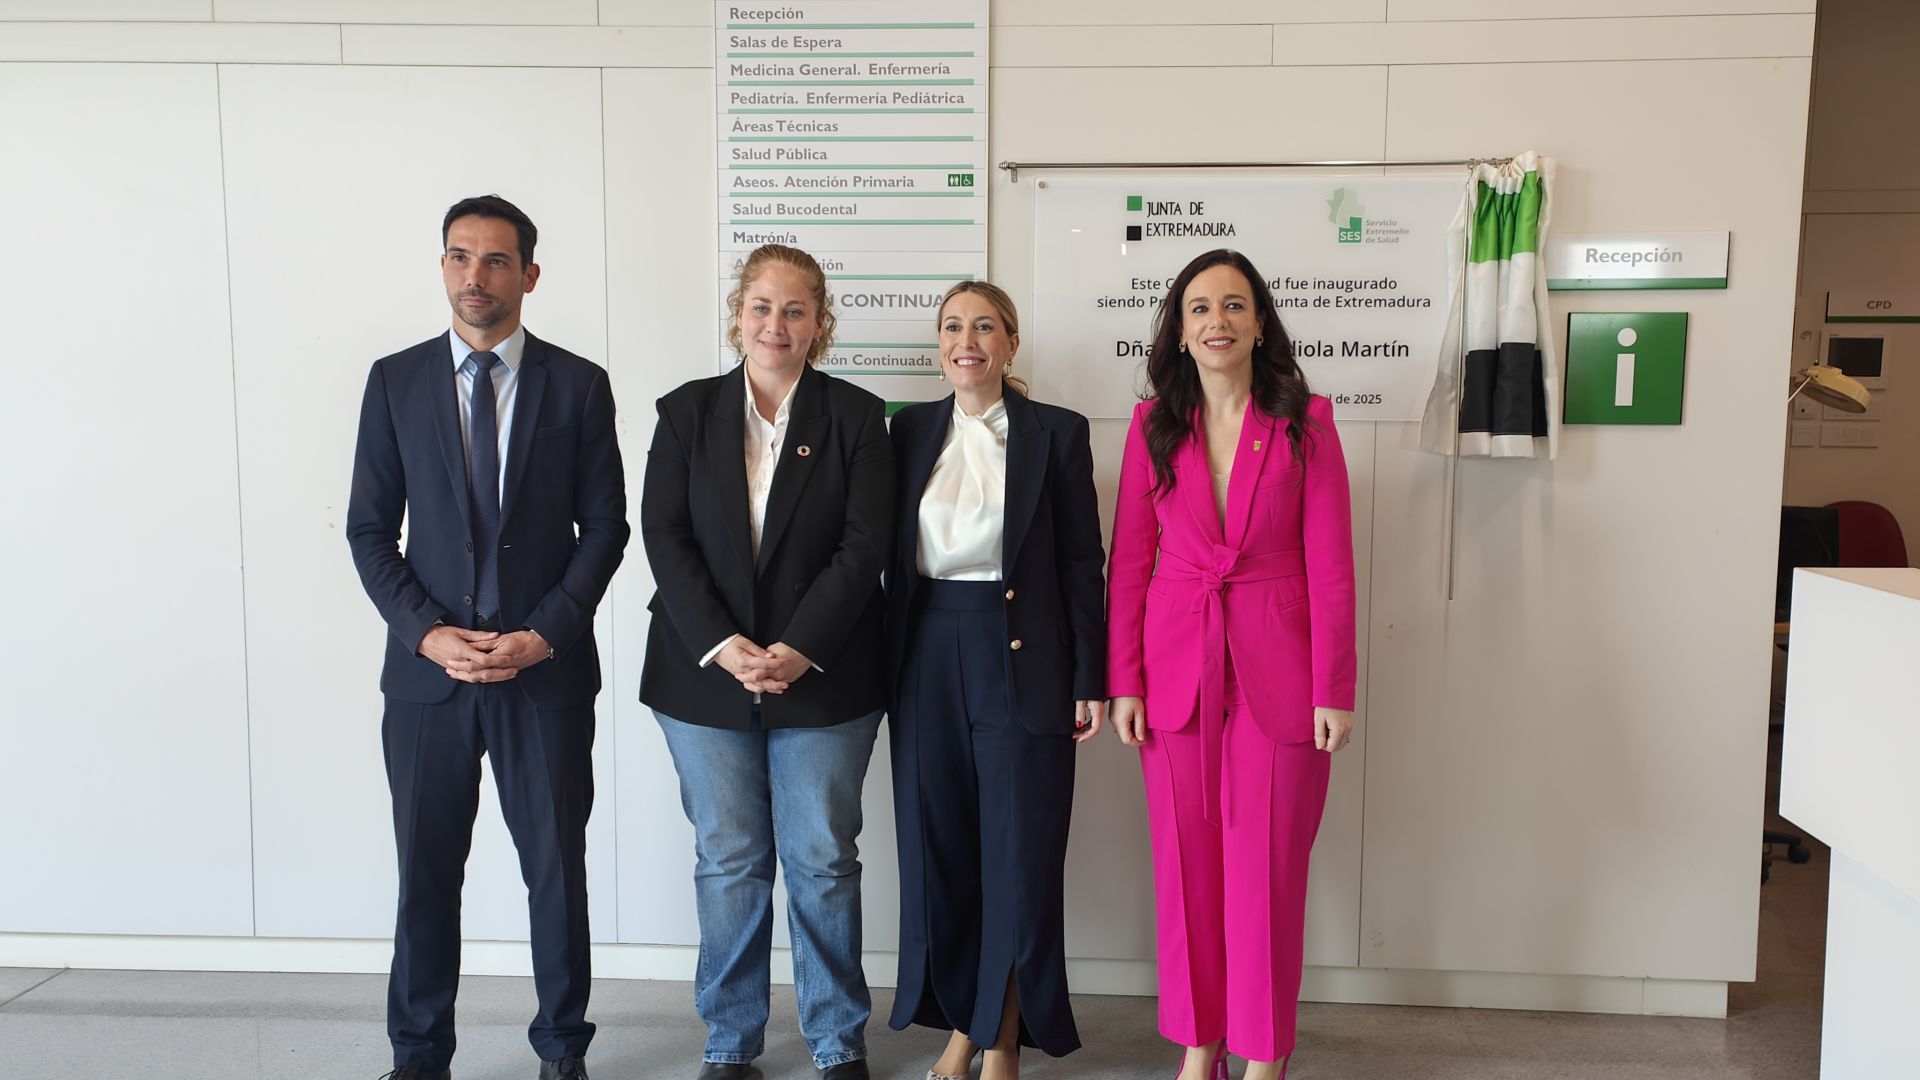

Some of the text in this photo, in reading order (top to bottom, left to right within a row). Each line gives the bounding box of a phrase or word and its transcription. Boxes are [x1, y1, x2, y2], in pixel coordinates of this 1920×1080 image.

[729, 6, 804, 23] Recepción
[730, 35, 843, 51] Salas de Espera
[730, 61, 951, 77] Medicina General. Enfermería
[731, 91, 965, 105] Pediatría. Enfermería Pediátrica
[731, 116, 839, 133] Áreas Técnicas
[731, 147, 828, 161] Salud Pública
[733, 175, 915, 189] Aseos. Atención Primaria
[732, 203, 857, 216] Salud Bucodental
[1146, 201, 1204, 218] JUNTA DE
[1145, 221, 1236, 237] EXTREMADURA
[1340, 231, 1360, 241] SES
[733, 231, 798, 245] Matrón/a
[1365, 236, 1399, 244] de Salud
[1585, 246, 1683, 268] Recepción
[1131, 278, 1161, 291] Este
[1285, 277, 1308, 290] fue
[1313, 277, 1398, 293] inaugurado
[1097, 295, 1145, 308] siendo
[1275, 296, 1308, 308] unta
[1313, 295, 1331, 308] de
[1335, 295, 1431, 309] Extremadura
[1866, 300, 1892, 310] CPD
[1341, 340, 1409, 358] Martín
[852, 353, 933, 367] Continuada
[1335, 393, 1350, 404] de
[1353, 394, 1382, 405] 2025
